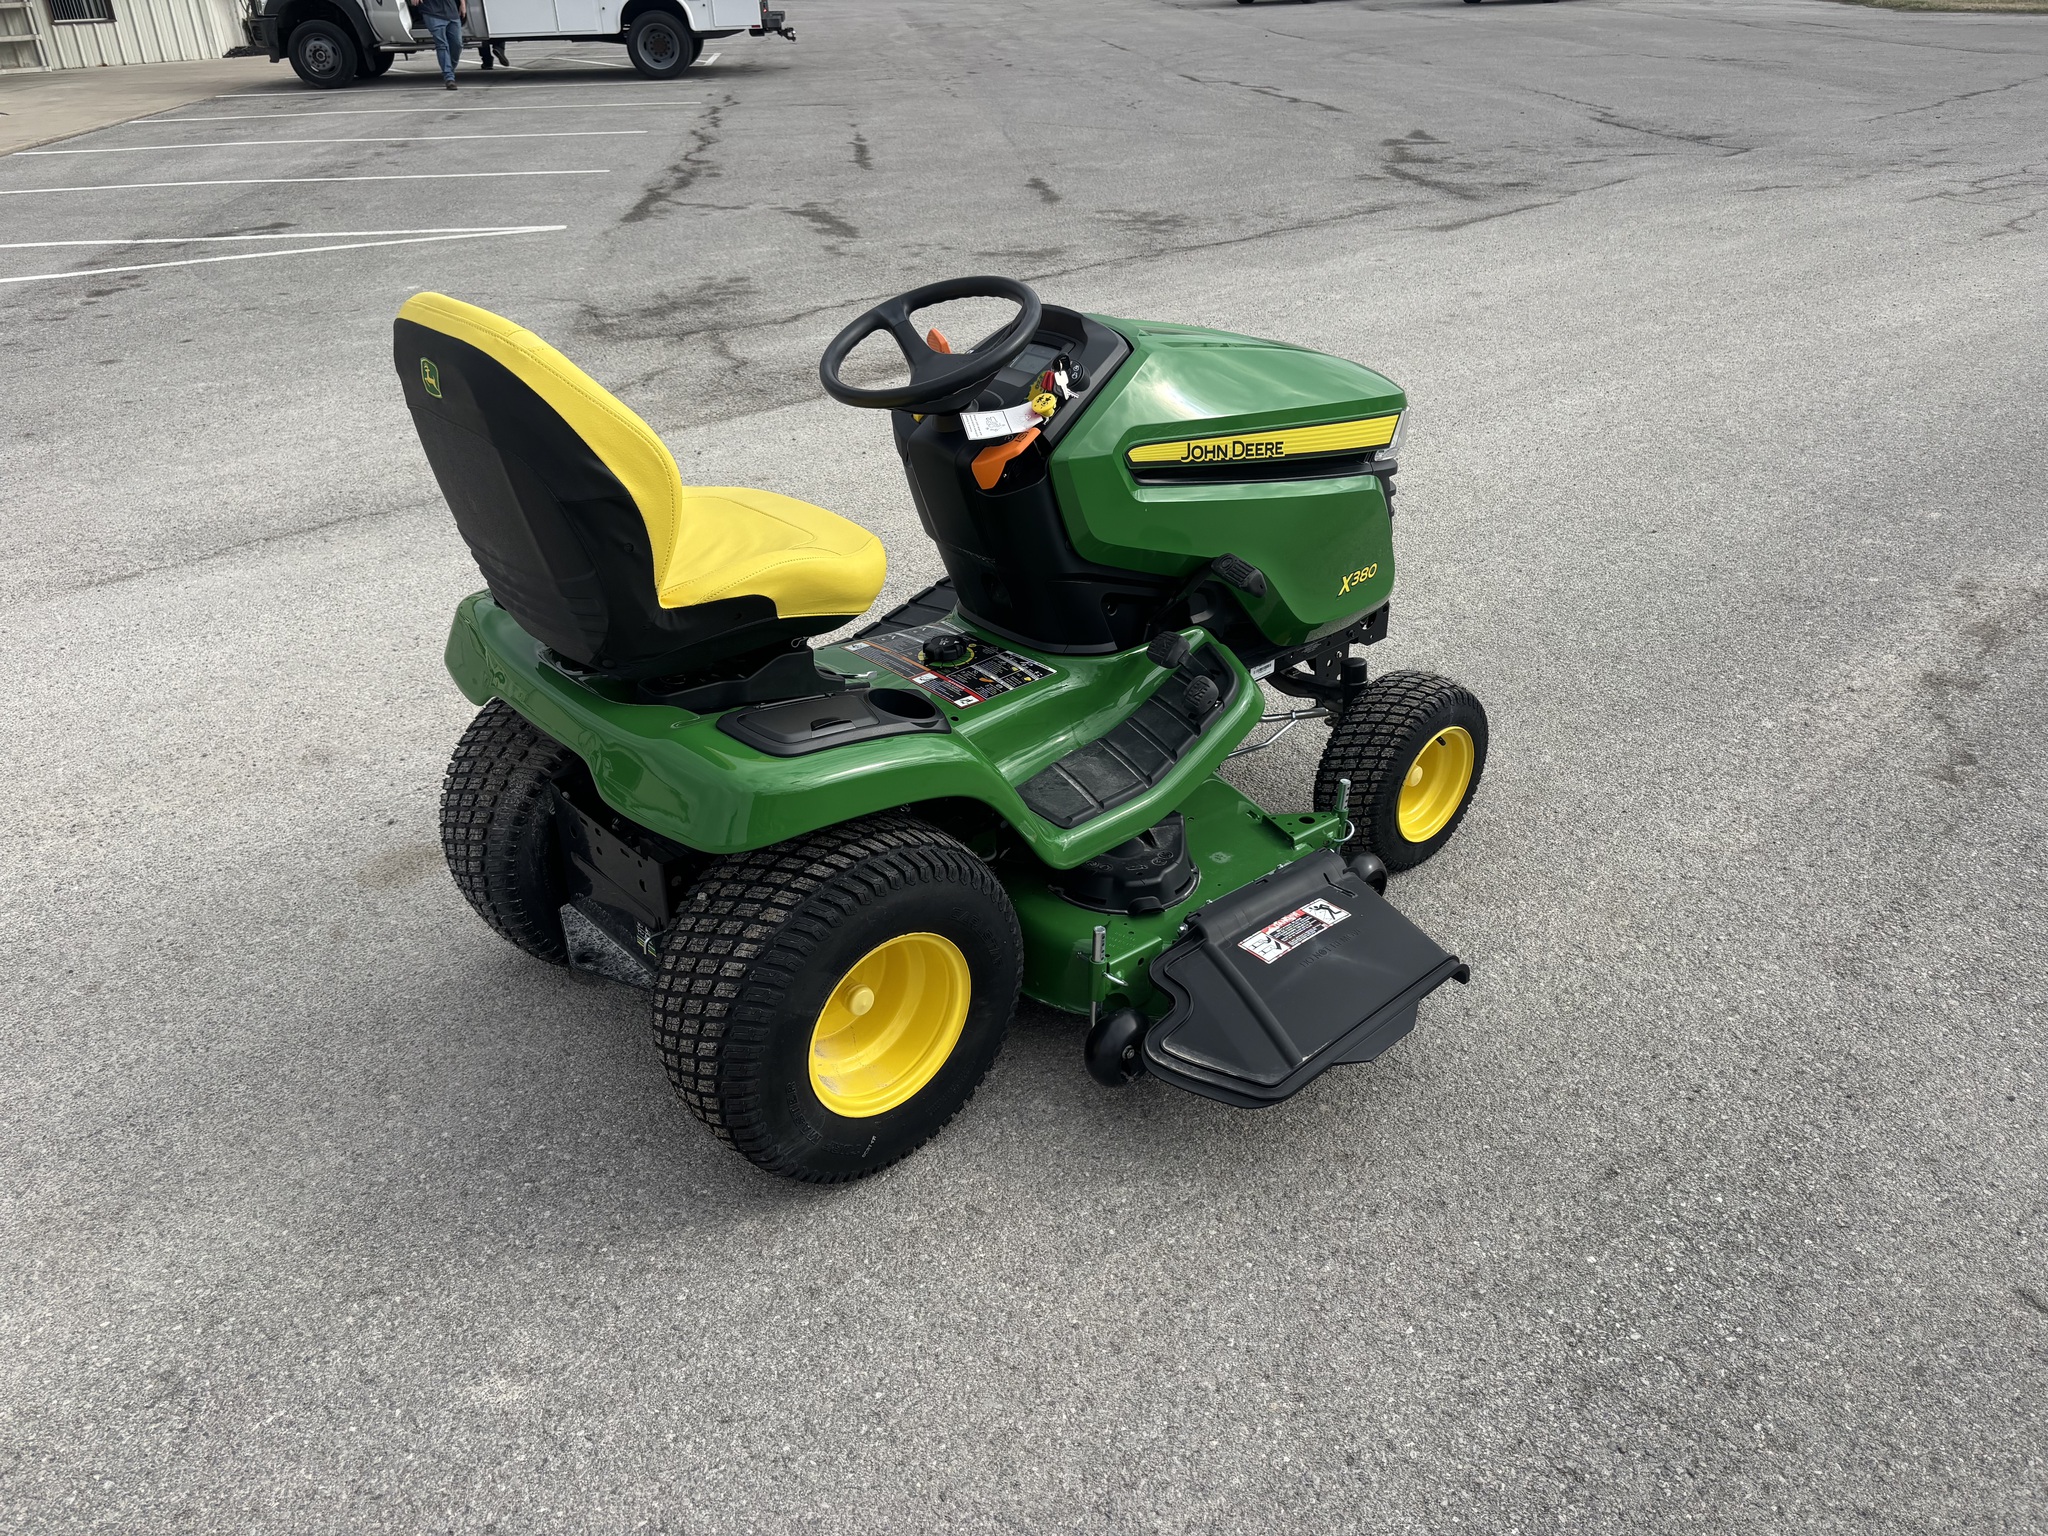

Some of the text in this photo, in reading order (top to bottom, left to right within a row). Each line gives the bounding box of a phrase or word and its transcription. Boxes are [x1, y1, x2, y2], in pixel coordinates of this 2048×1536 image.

[1181, 440, 1284, 461] JOHN DEERE
[1337, 563, 1378, 597] X380
[785, 1080, 823, 1147] MASTER
